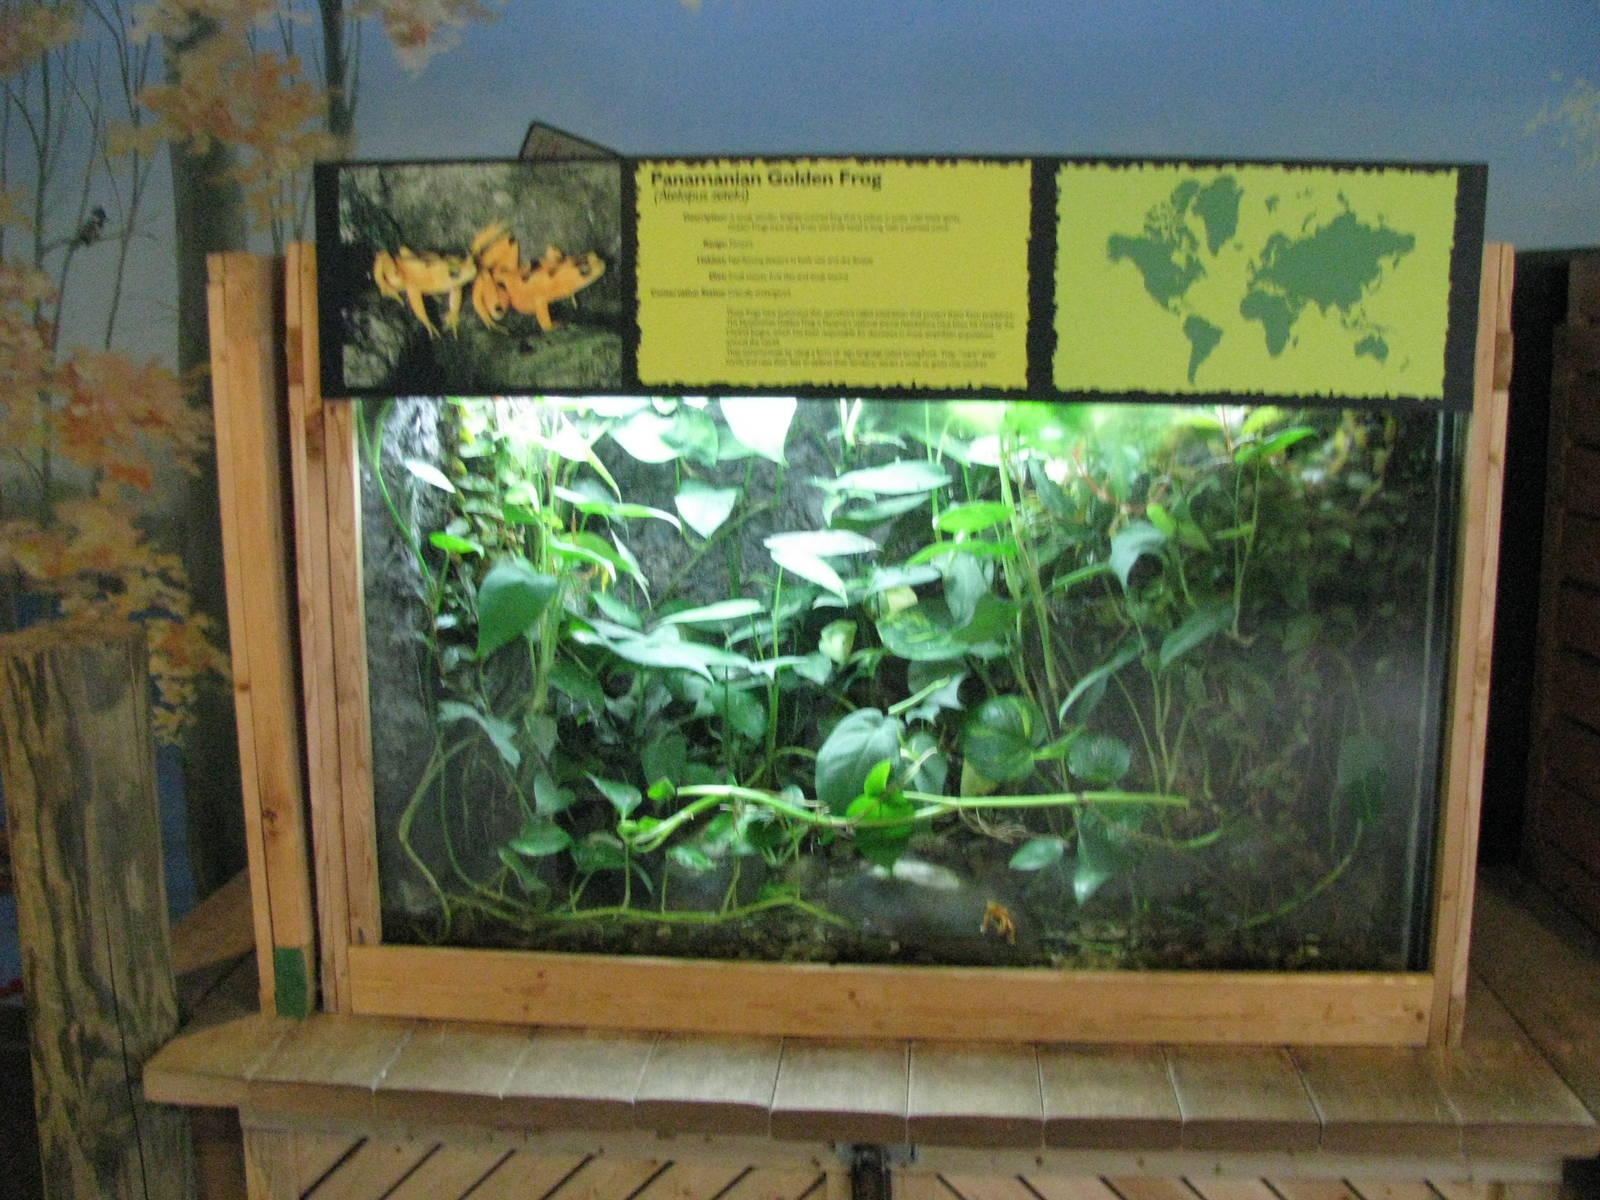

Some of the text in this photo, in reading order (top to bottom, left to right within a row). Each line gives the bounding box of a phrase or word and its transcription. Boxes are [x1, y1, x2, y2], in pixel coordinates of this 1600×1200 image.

[651, 171, 882, 192] Panamanian Golden Frog
